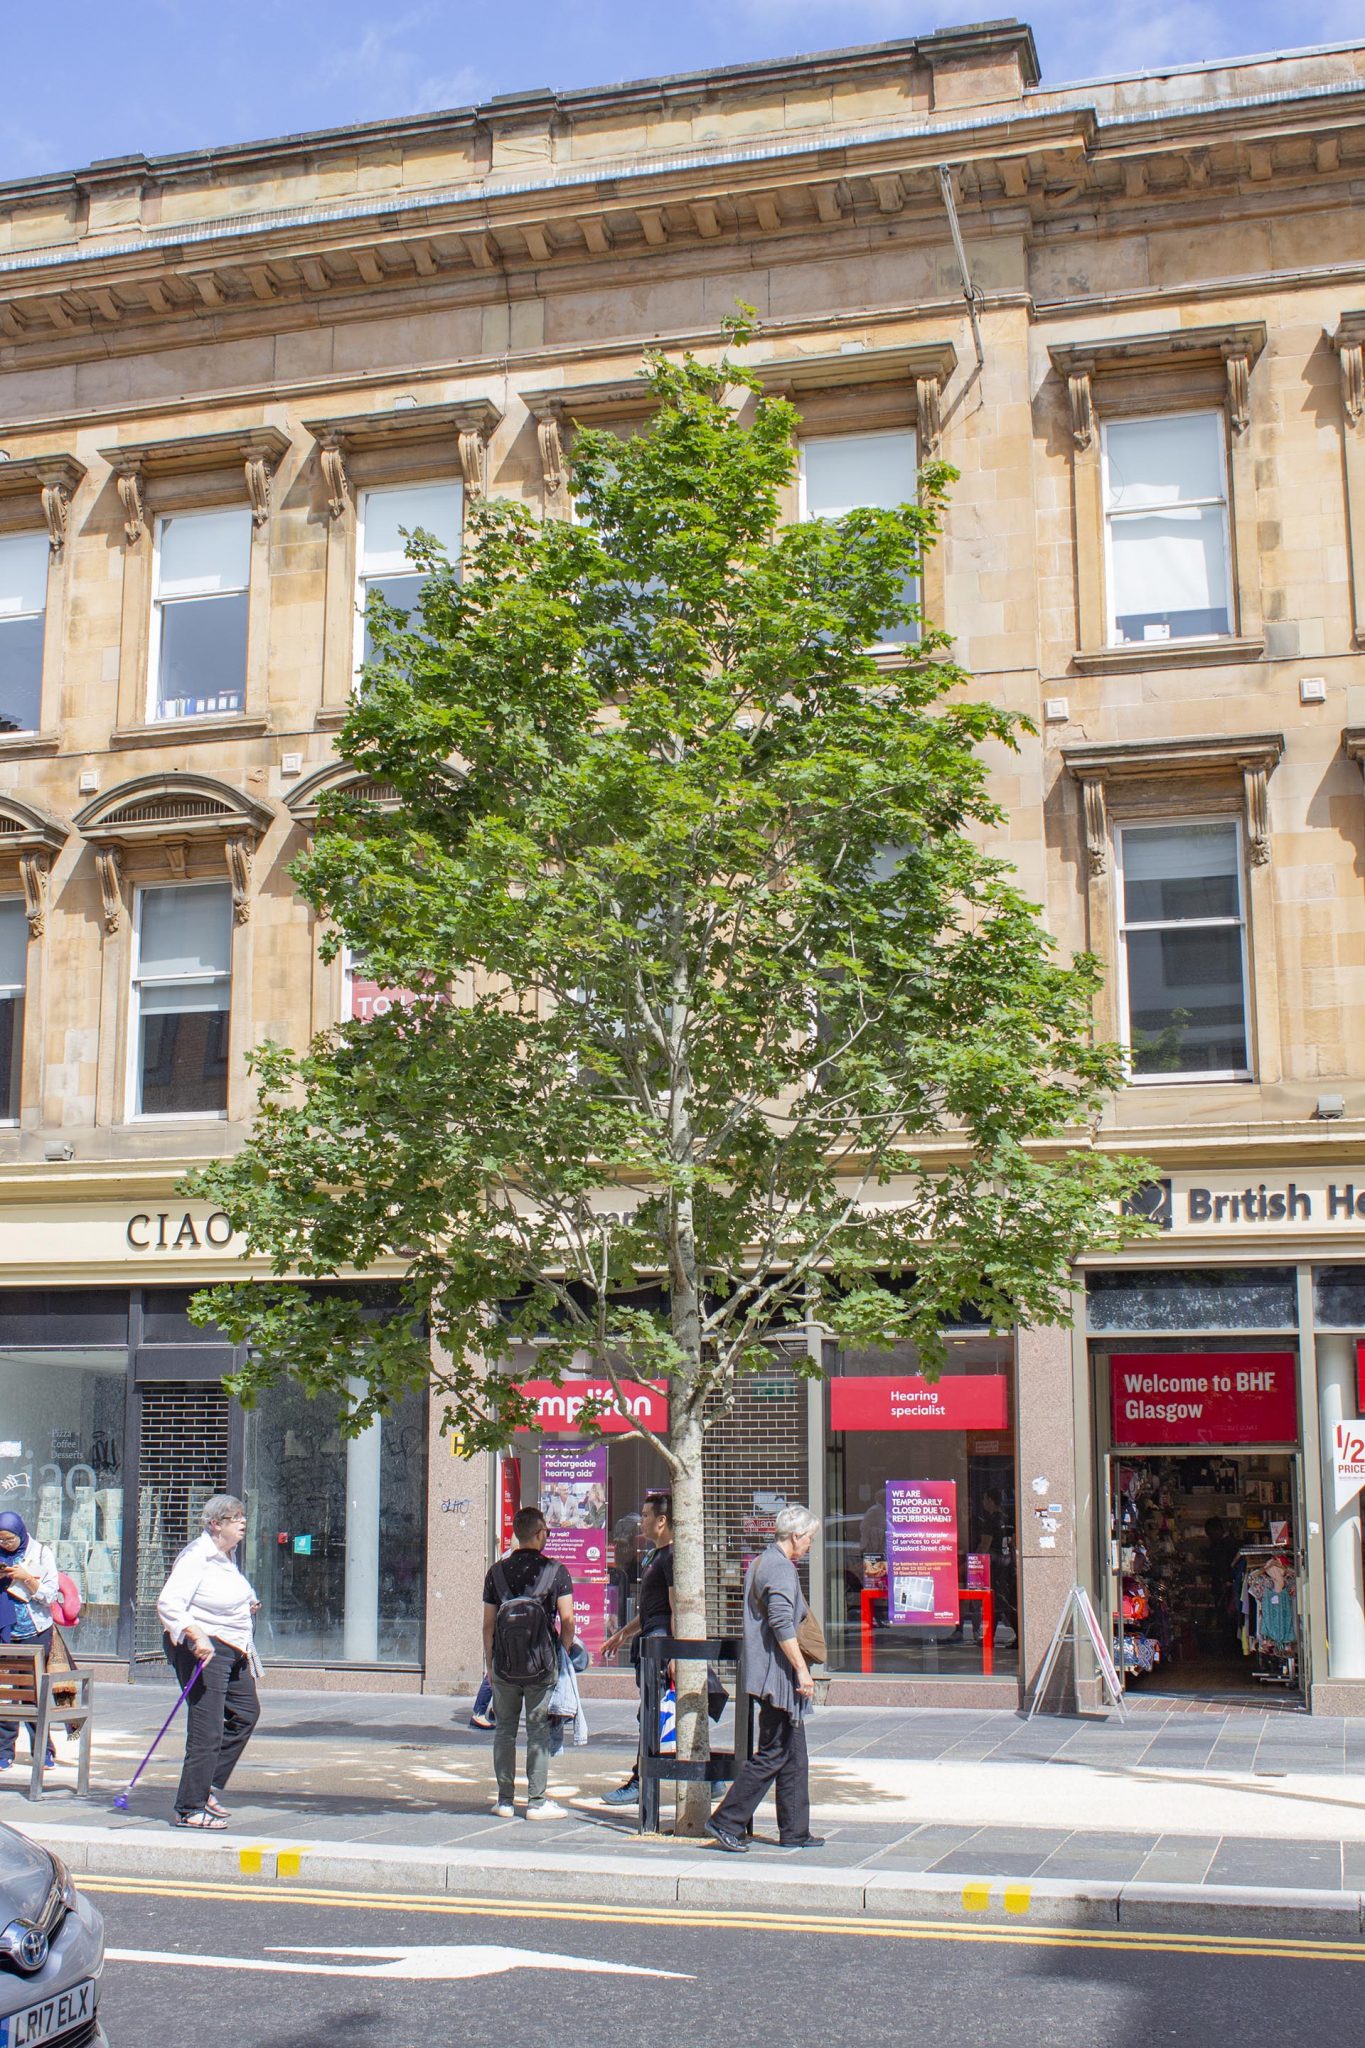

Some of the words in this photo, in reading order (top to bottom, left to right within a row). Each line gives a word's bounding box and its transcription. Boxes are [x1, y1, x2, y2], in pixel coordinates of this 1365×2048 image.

[358, 996, 392, 1016] TO
[1189, 1183, 1311, 1222] British
[126, 1212, 233, 1247] CIAO
[1124, 1374, 1208, 1393] Welcome
[1212, 1375, 1231, 1392] to
[1236, 1372, 1275, 1392] BHF
[890, 1391, 938, 1403] Hearing
[890, 1405, 946, 1418] specialist
[1125, 1400, 1203, 1423] Glasgow
[52, 1429, 72, 1438] Pizza
[51, 1439, 77, 1448] Coffee
[51, 1450, 84, 1459] Desserts
[545, 1460, 596, 1469] rechargeable
[545, 1469, 575, 1479] hearing
[892, 1490, 904, 1498] WE
[905, 1490, 920, 1498] ARE
[892, 1515, 952, 1523] REFURBISHMENT
[14, 2003, 55, 2048] LR17
[57, 1986, 89, 2028] ELX
